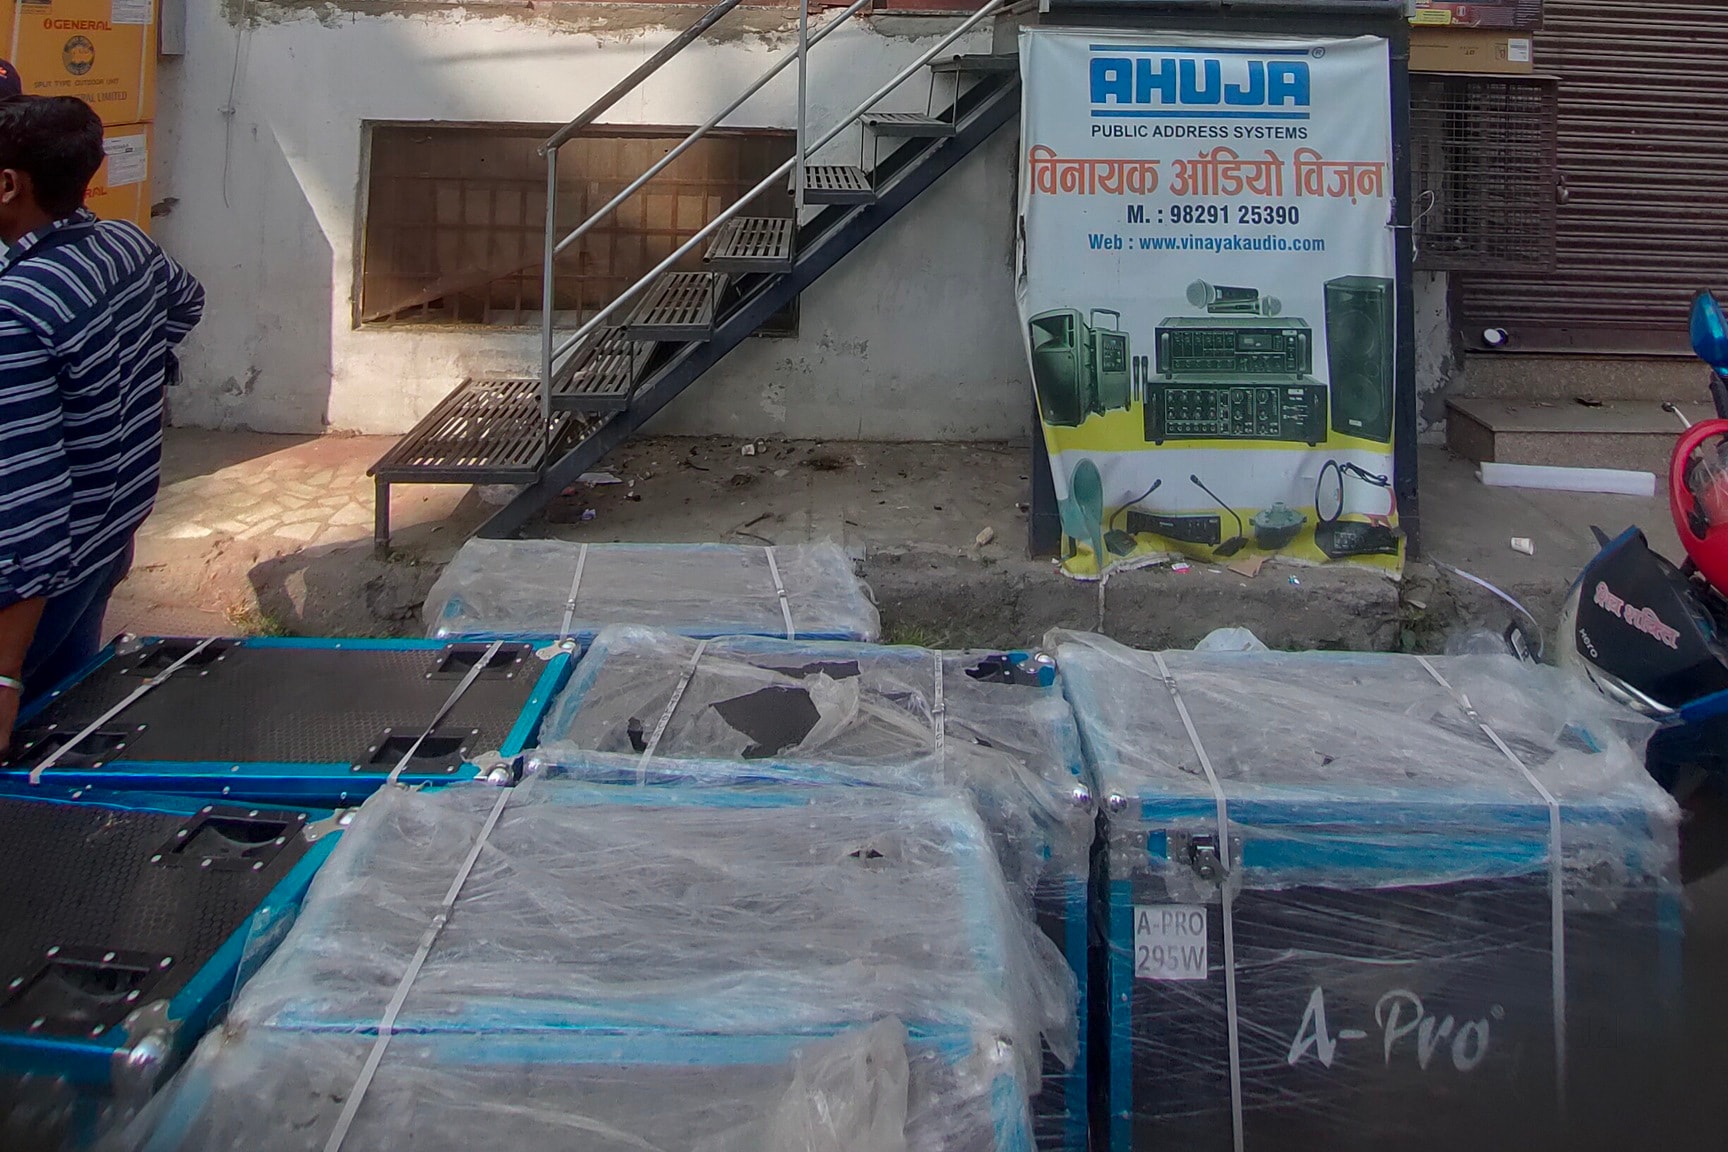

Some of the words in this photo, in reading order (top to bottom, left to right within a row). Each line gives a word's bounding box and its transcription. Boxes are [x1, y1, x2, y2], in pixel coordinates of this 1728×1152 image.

[54, 19, 111, 30] GENERAL
[1090, 57, 1310, 106] AHUJA
[1091, 124, 1148, 138] PUBLIC
[1153, 125, 1229, 139] ADDRESS
[1233, 126, 1308, 140] SYSTEMS
[1029, 145, 1160, 196] विनायक
[1169, 145, 1285, 197] ऑडियो
[1293, 147, 1386, 205] विज़न
[1127, 205, 1151, 223] M.
[1170, 205, 1229, 224] 98291
[1238, 206, 1299, 224] 25390
[1088, 234, 1123, 250] Web
[1139, 235, 1325, 253] www.vinayakaudio.com
[1579, 628, 1598, 658] Hero
[1137, 911, 1205, 937] A-PRO
[1138, 945, 1205, 972] 295W
[1287, 985, 1490, 1072] A-Pro
